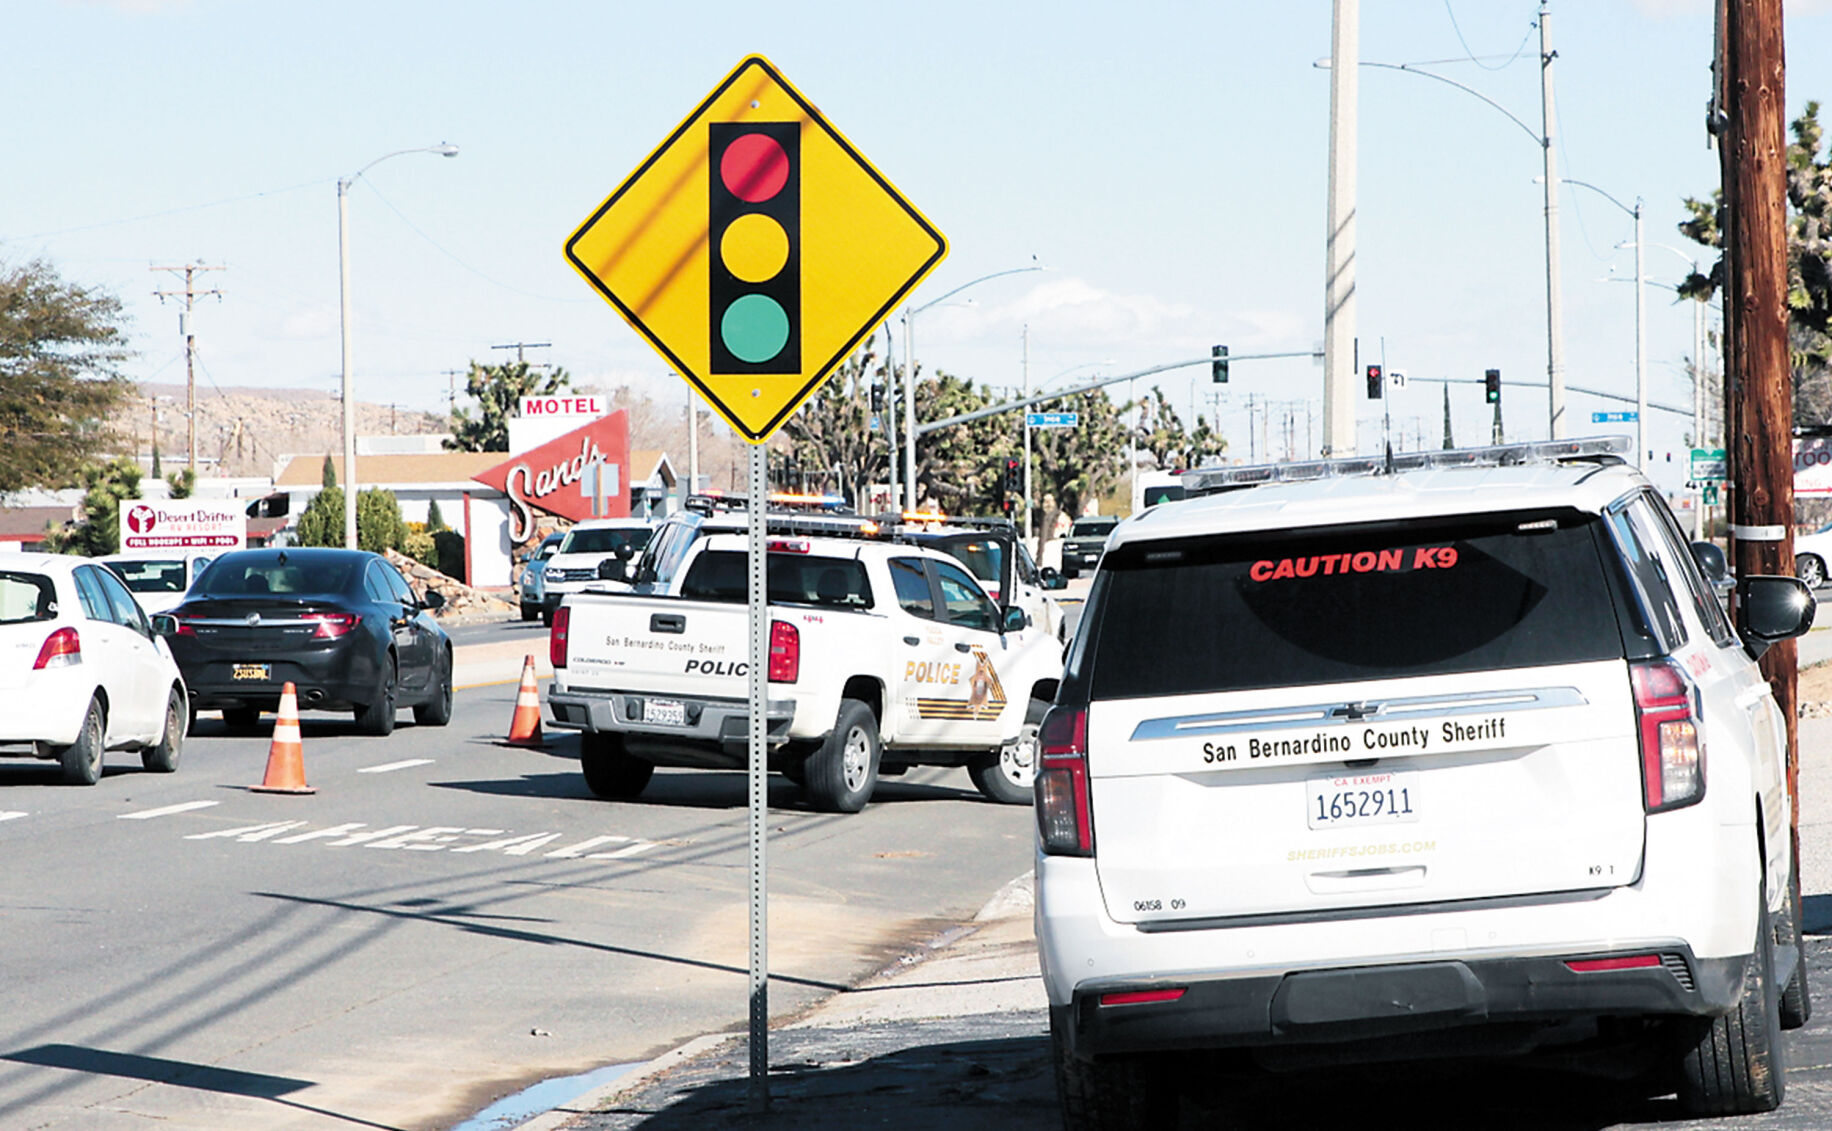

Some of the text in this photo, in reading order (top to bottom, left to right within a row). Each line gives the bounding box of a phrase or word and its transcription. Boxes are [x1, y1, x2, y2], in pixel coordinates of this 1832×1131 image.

[526, 398, 601, 414] MOTEL
[506, 436, 607, 543] Sands
[158, 509, 235, 523] Desert Drifter
[187, 522, 222, 532] RESORT
[129, 537, 146, 547] FULL
[215, 536, 235, 545] POOL
[1250, 547, 1458, 582] CAUTION K9
[606, 636, 726, 655] San Bernardino County Sheriff
[684, 659, 749, 676] POLIC
[904, 661, 961, 685] POLICE
[1203, 718, 1506, 763] San Bernardino County Sheriff
[1334, 774, 1392, 788] CA EXEMPT
[1316, 787, 1413, 821] 1652911
[182, 820, 658, 859] AHEAD
[1286, 840, 1438, 862] SHERIFFSJOBS.COM
[1589, 865, 1602, 876] K9
[1133, 898, 1187, 912] 06158 09
